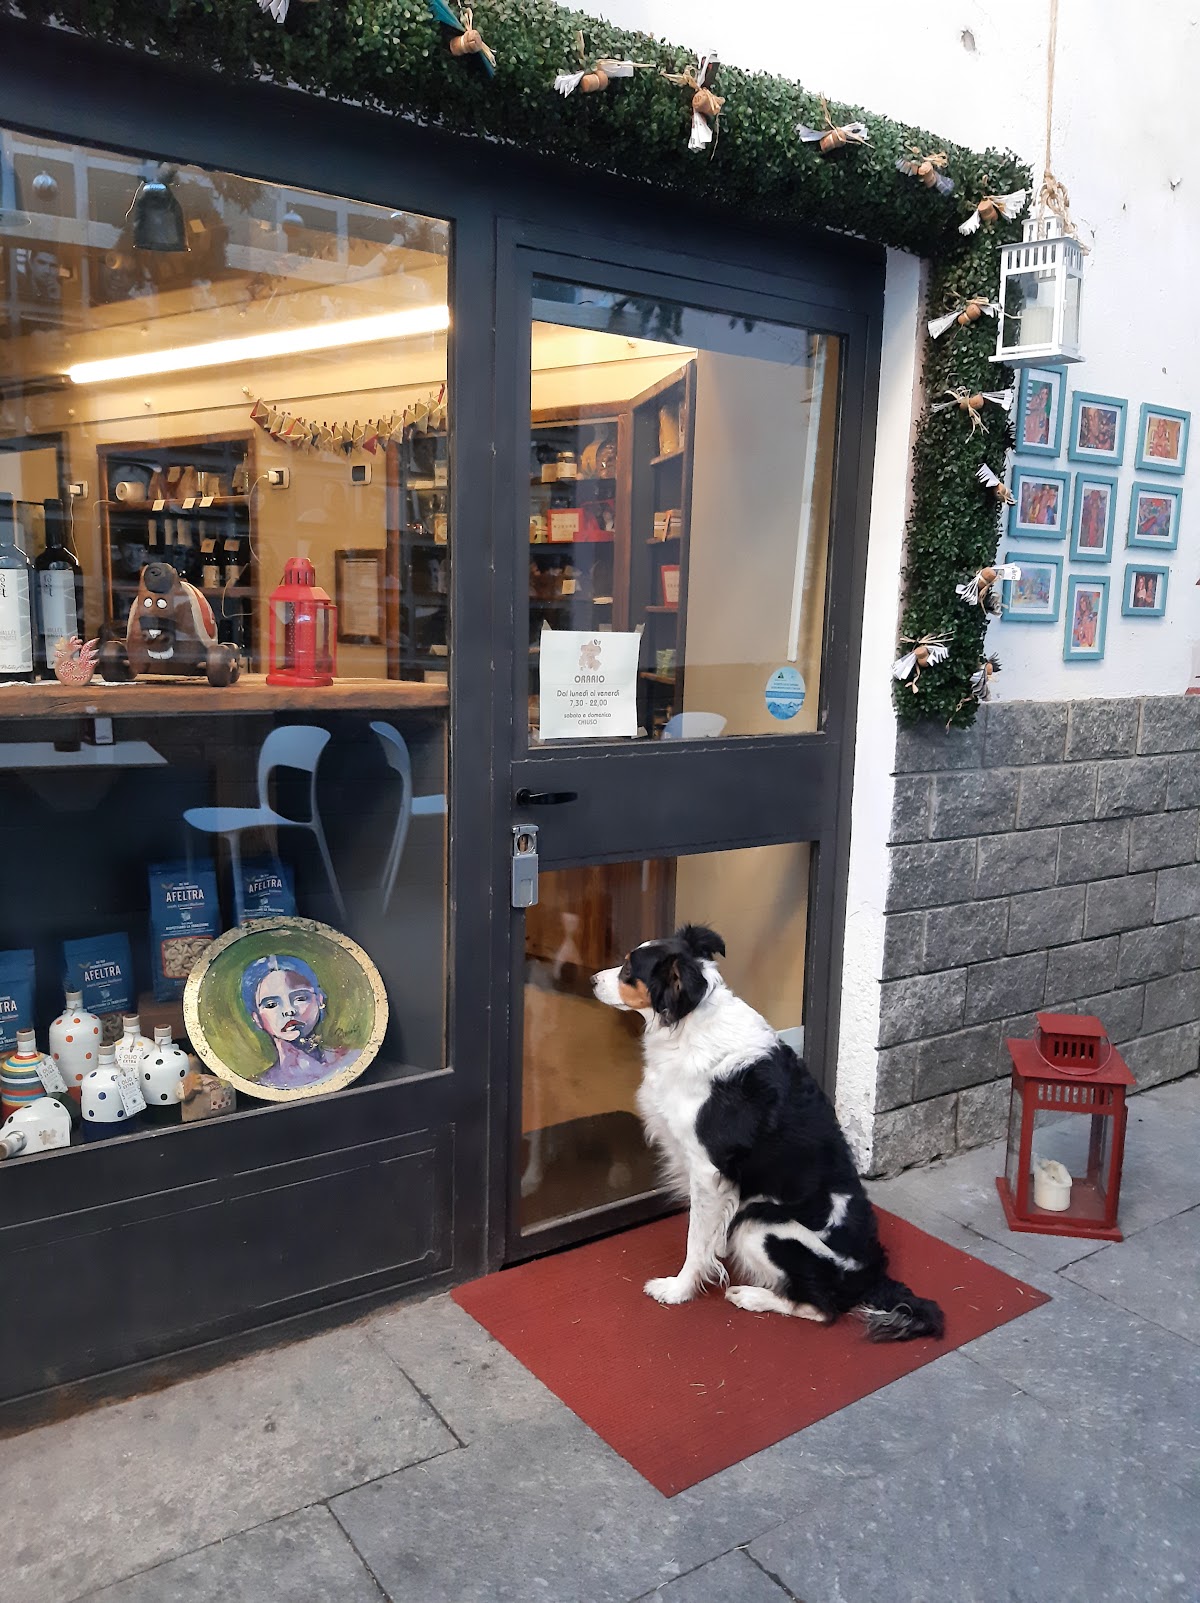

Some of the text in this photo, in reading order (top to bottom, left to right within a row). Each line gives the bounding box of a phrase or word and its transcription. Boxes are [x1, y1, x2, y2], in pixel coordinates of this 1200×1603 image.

[574, 675, 605, 683] ORARIO
[248, 879, 282, 894] AFELTRA
[166, 889, 204, 903] AFELTRA
[84, 965, 121, 982] AFELTRA
